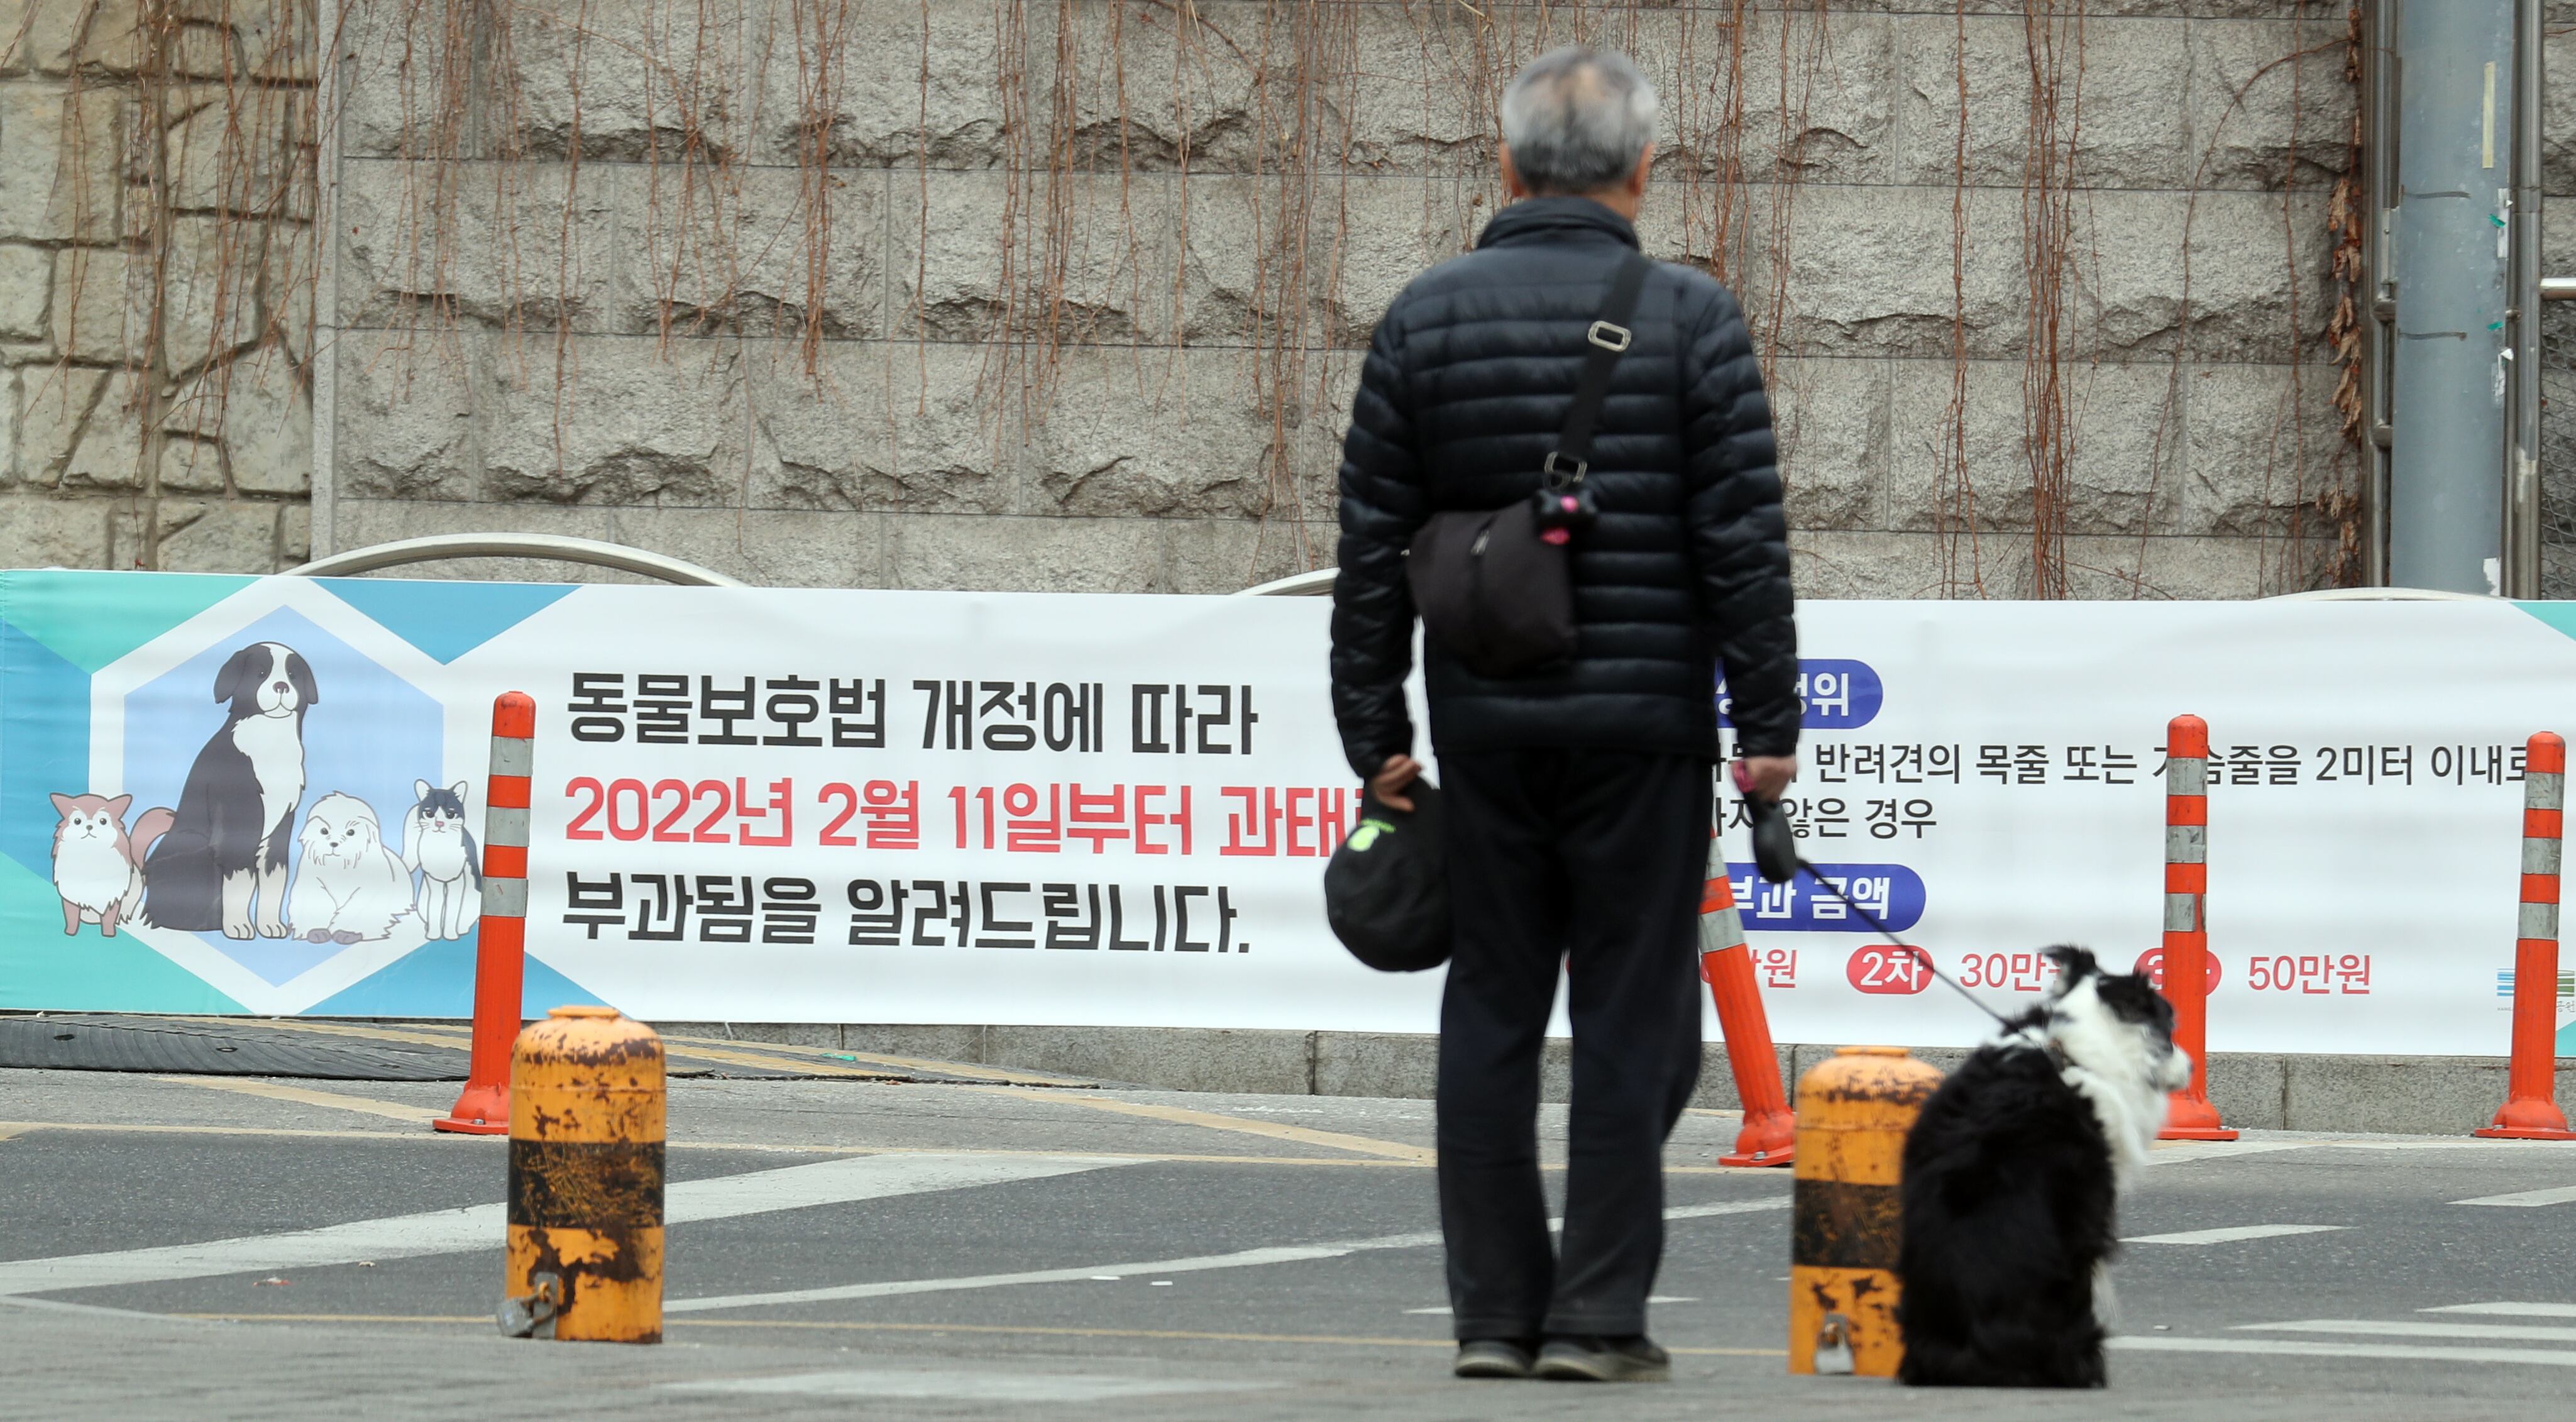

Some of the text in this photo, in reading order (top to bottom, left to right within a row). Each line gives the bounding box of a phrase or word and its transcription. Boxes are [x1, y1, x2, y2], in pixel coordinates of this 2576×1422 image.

[568, 672, 1258, 755] 동물보호법 개정에 따라
[1816, 743, 1959, 784] 반려견의
[1976, 744, 2049, 785] 목줄
[2063, 744, 2137, 785] 또는
[2316, 745, 2412, 786] 2미터
[566, 776, 1363, 857] 2022년 2월 11일부터 과태
[1780, 797, 1850, 839] 않은
[1864, 798, 1937, 840] 경우
[563, 871, 1250, 954] 부과됨을 알려드립니다.
[1810, 876, 1891, 920] 금액
[1860, 951, 1924, 990] 2차
[2249, 954, 2370, 995] 50만원
